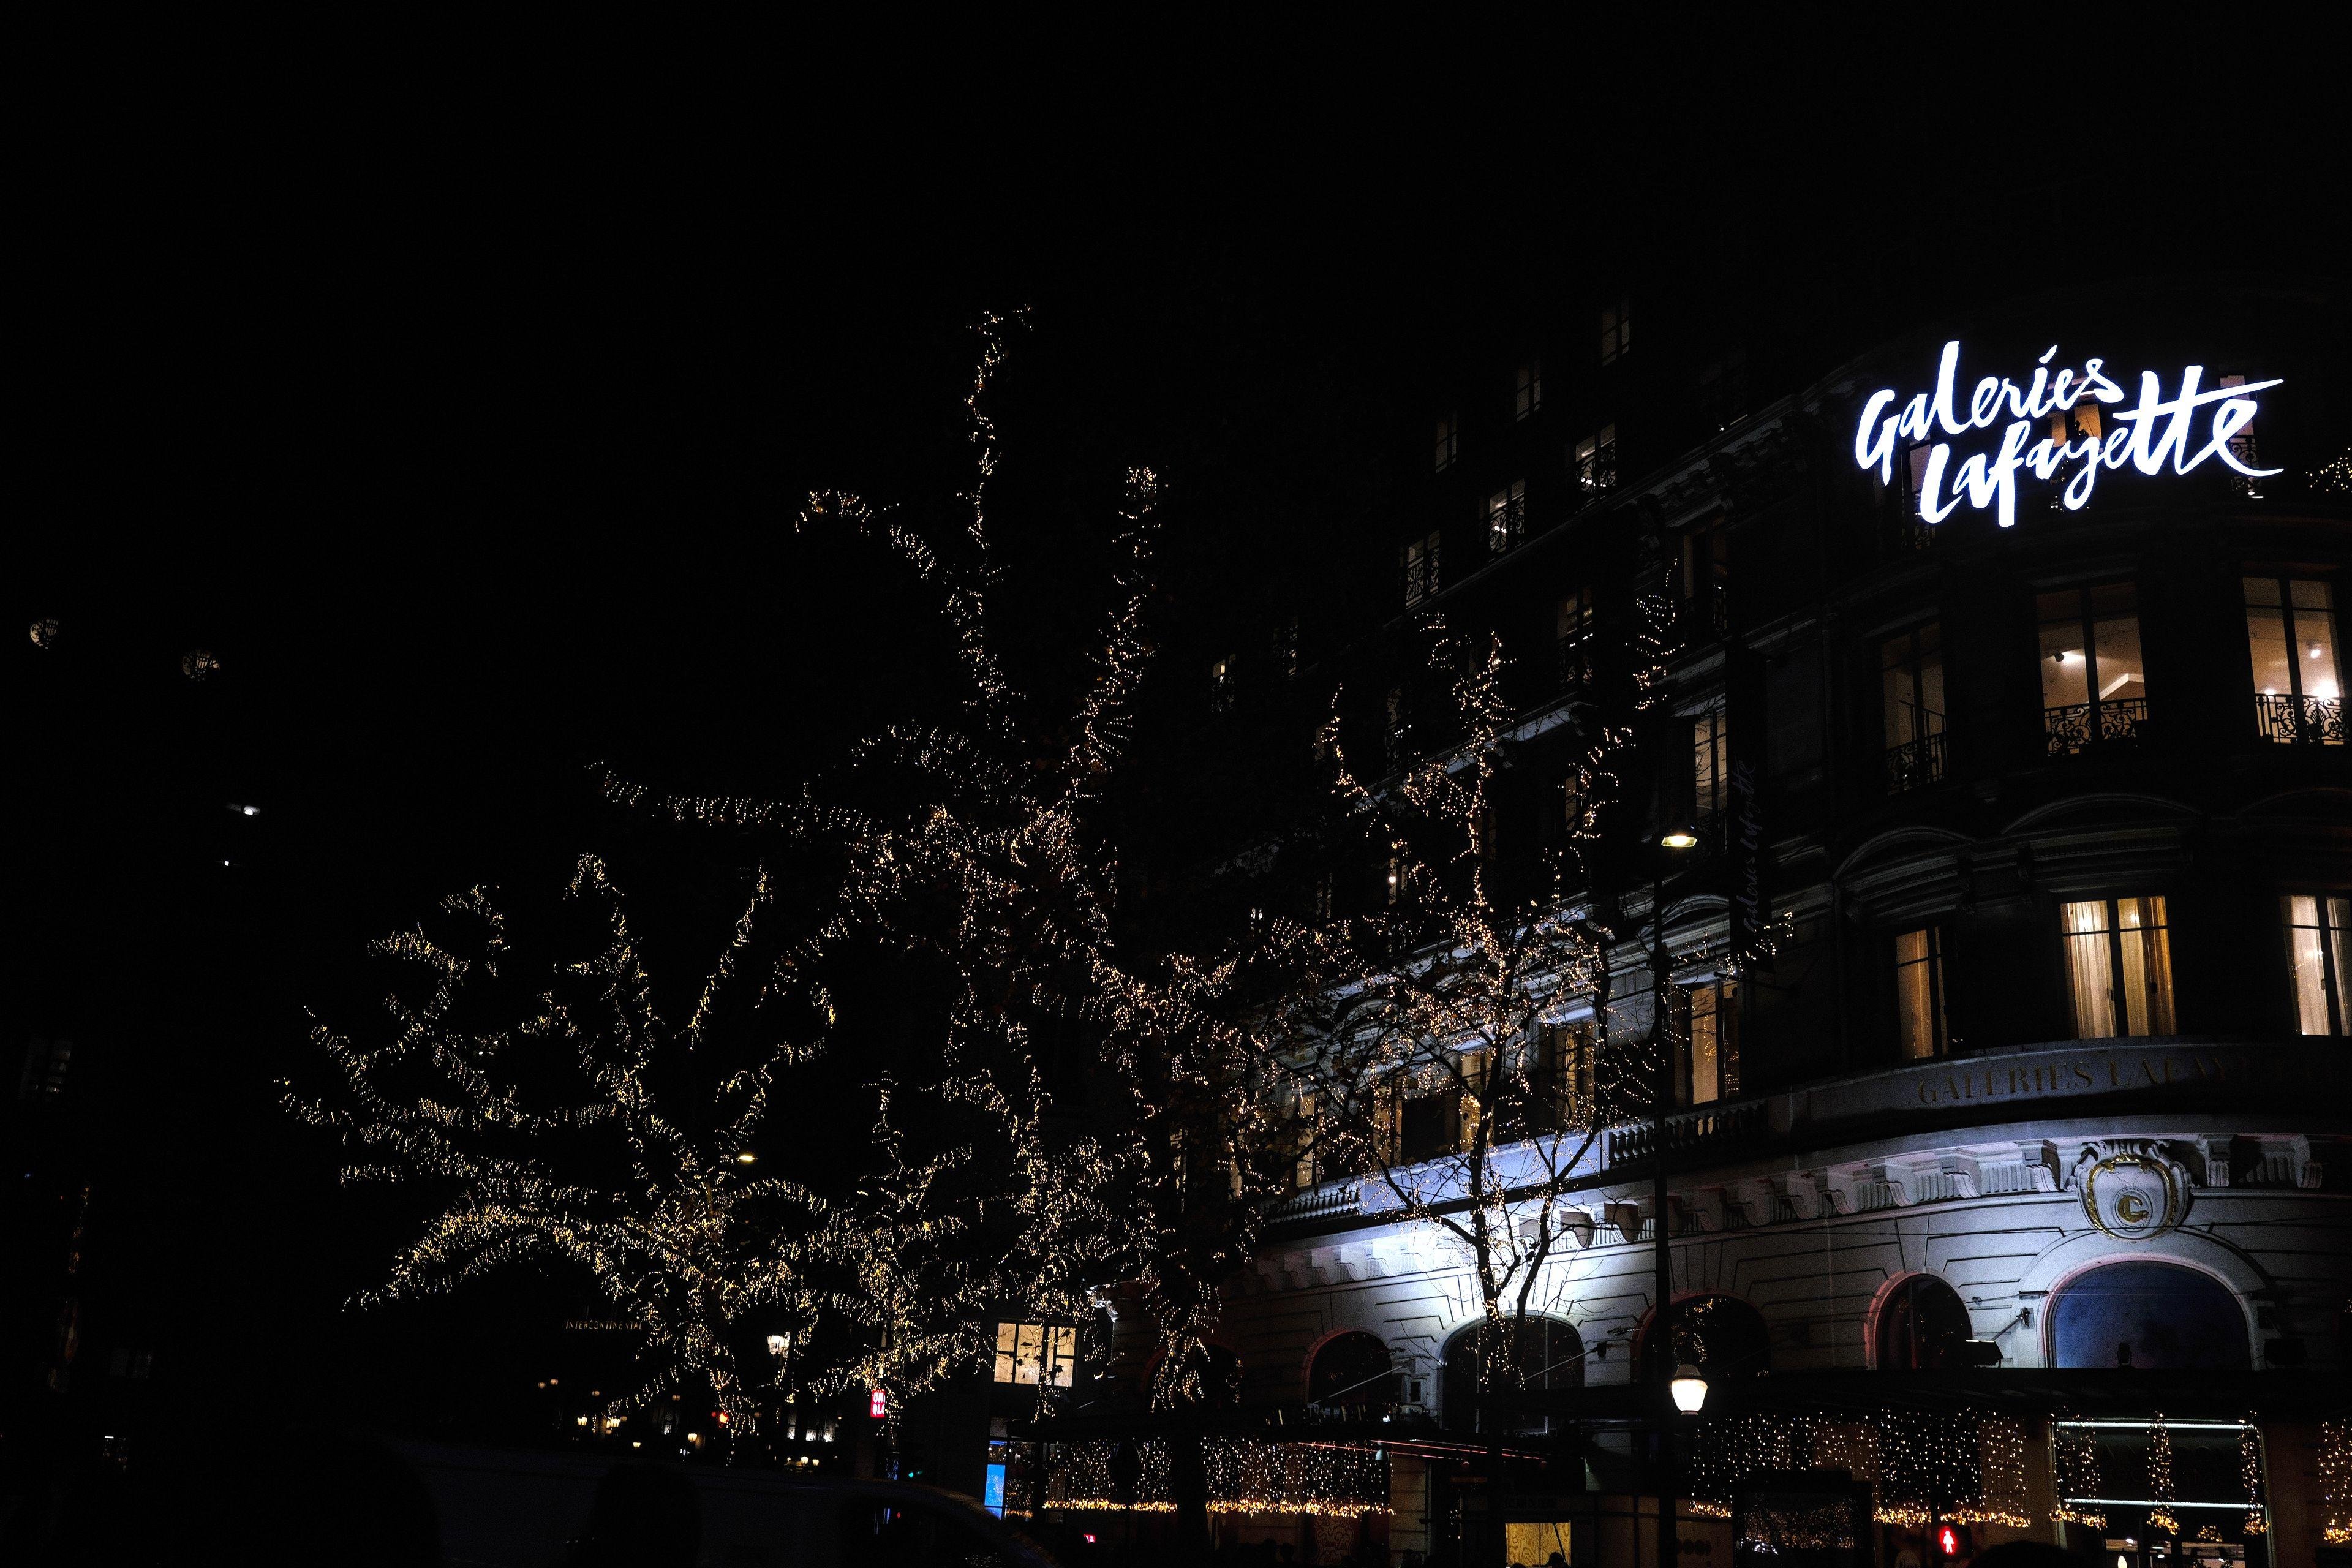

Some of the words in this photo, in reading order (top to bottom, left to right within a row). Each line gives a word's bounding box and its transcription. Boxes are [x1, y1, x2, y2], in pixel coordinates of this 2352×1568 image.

[1855, 340, 2125, 486] Galeries
[1917, 364, 2285, 529] Lafayette
[1917, 1061, 2093, 1104] GALERIES
[2109, 1054, 2282, 1089] LAFAY
[565, 1317, 643, 1330] INTERCONTINENTAL
